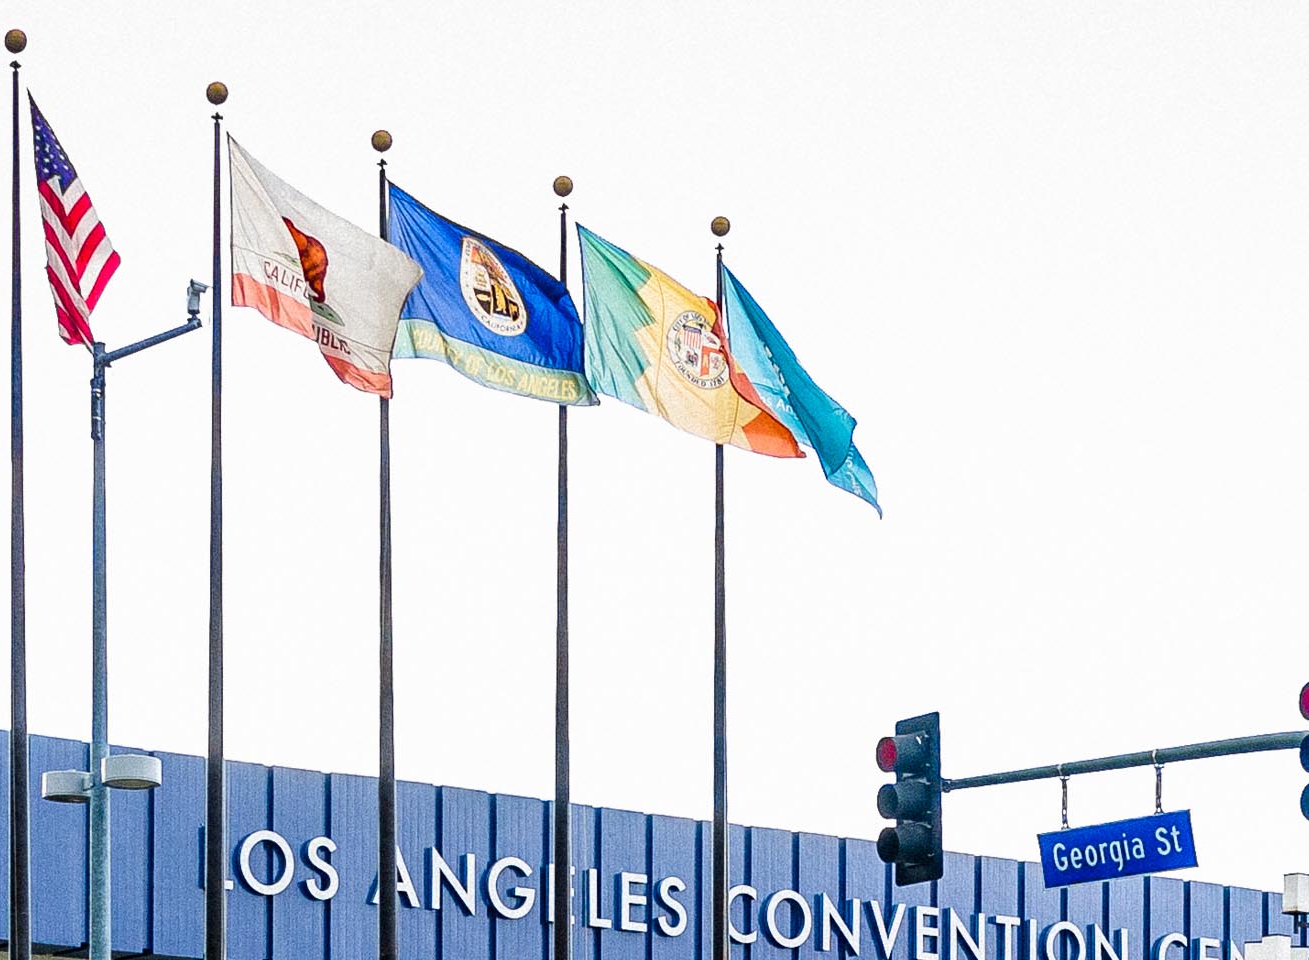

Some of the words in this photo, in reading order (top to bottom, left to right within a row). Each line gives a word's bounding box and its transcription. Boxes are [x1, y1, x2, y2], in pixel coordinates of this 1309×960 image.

[264, 261, 310, 299] CALIF
[465, 353, 483, 376] OF
[485, 362, 516, 386] LOS
[517, 372, 577, 401] ANGELES
[204, 829, 339, 900] OS
[1053, 832, 1145, 872] Georgia
[1155, 825, 1182, 856] St
